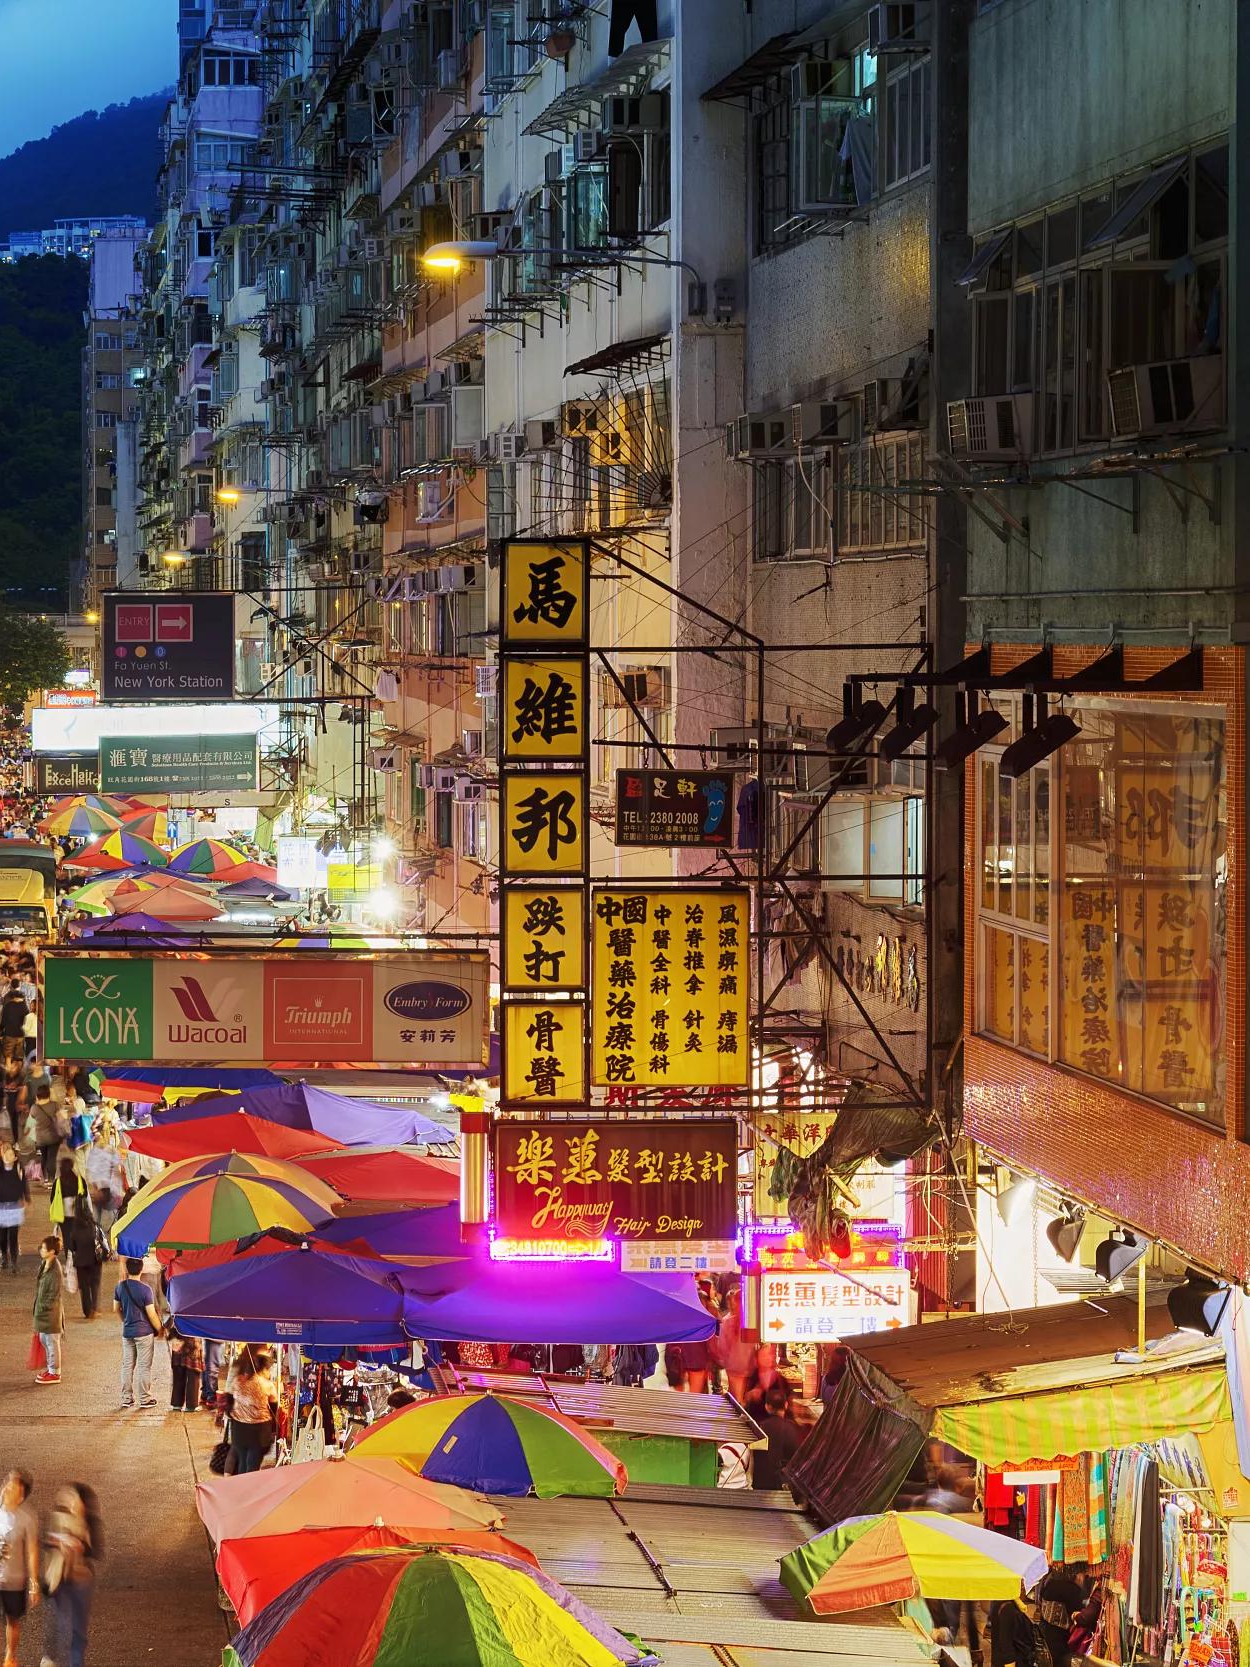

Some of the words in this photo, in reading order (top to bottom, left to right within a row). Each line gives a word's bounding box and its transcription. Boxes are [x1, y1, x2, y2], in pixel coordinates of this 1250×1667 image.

[118, 617, 149, 626] ENTRY
[131, 661, 157, 671] Yuen
[159, 660, 172, 671] St.
[114, 676, 142, 688] New
[147, 676, 175, 688] York
[179, 676, 223, 688] Station
[650, 812, 673, 824] 2380
[675, 812, 699, 825] 2008
[391, 995, 429, 1011] Embry
[434, 995, 464, 1009] Form
[284, 1005, 352, 1027] Triumph
[59, 1005, 141, 1046] LEONA
[168, 1024, 247, 1044] Wacoal
[398, 1028, 457, 1044] 安莉芳
[613, 1216, 652, 1237] Hair
[655, 1215, 704, 1238] Design
[649, 1256, 708, 1270] 請登二樓
[795, 1316, 878, 1335] 請登二樓
